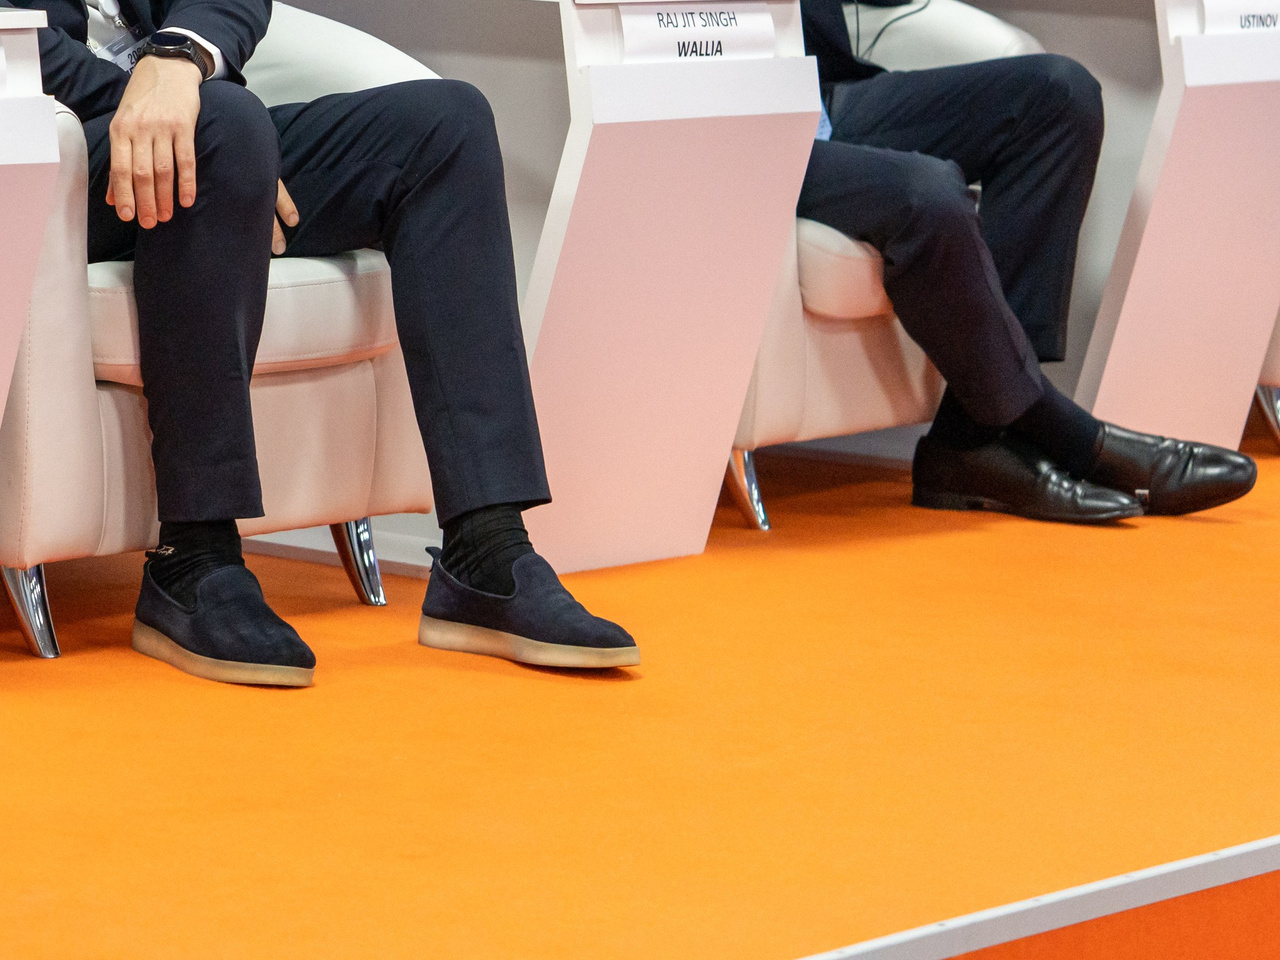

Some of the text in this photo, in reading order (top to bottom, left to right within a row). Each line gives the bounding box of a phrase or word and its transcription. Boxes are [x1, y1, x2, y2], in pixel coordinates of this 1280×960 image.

[656, 11, 738, 29] RAJ JIT SINGH
[1240, 13, 1279, 29] USTINOV
[676, 39, 723, 58] WALLIA
